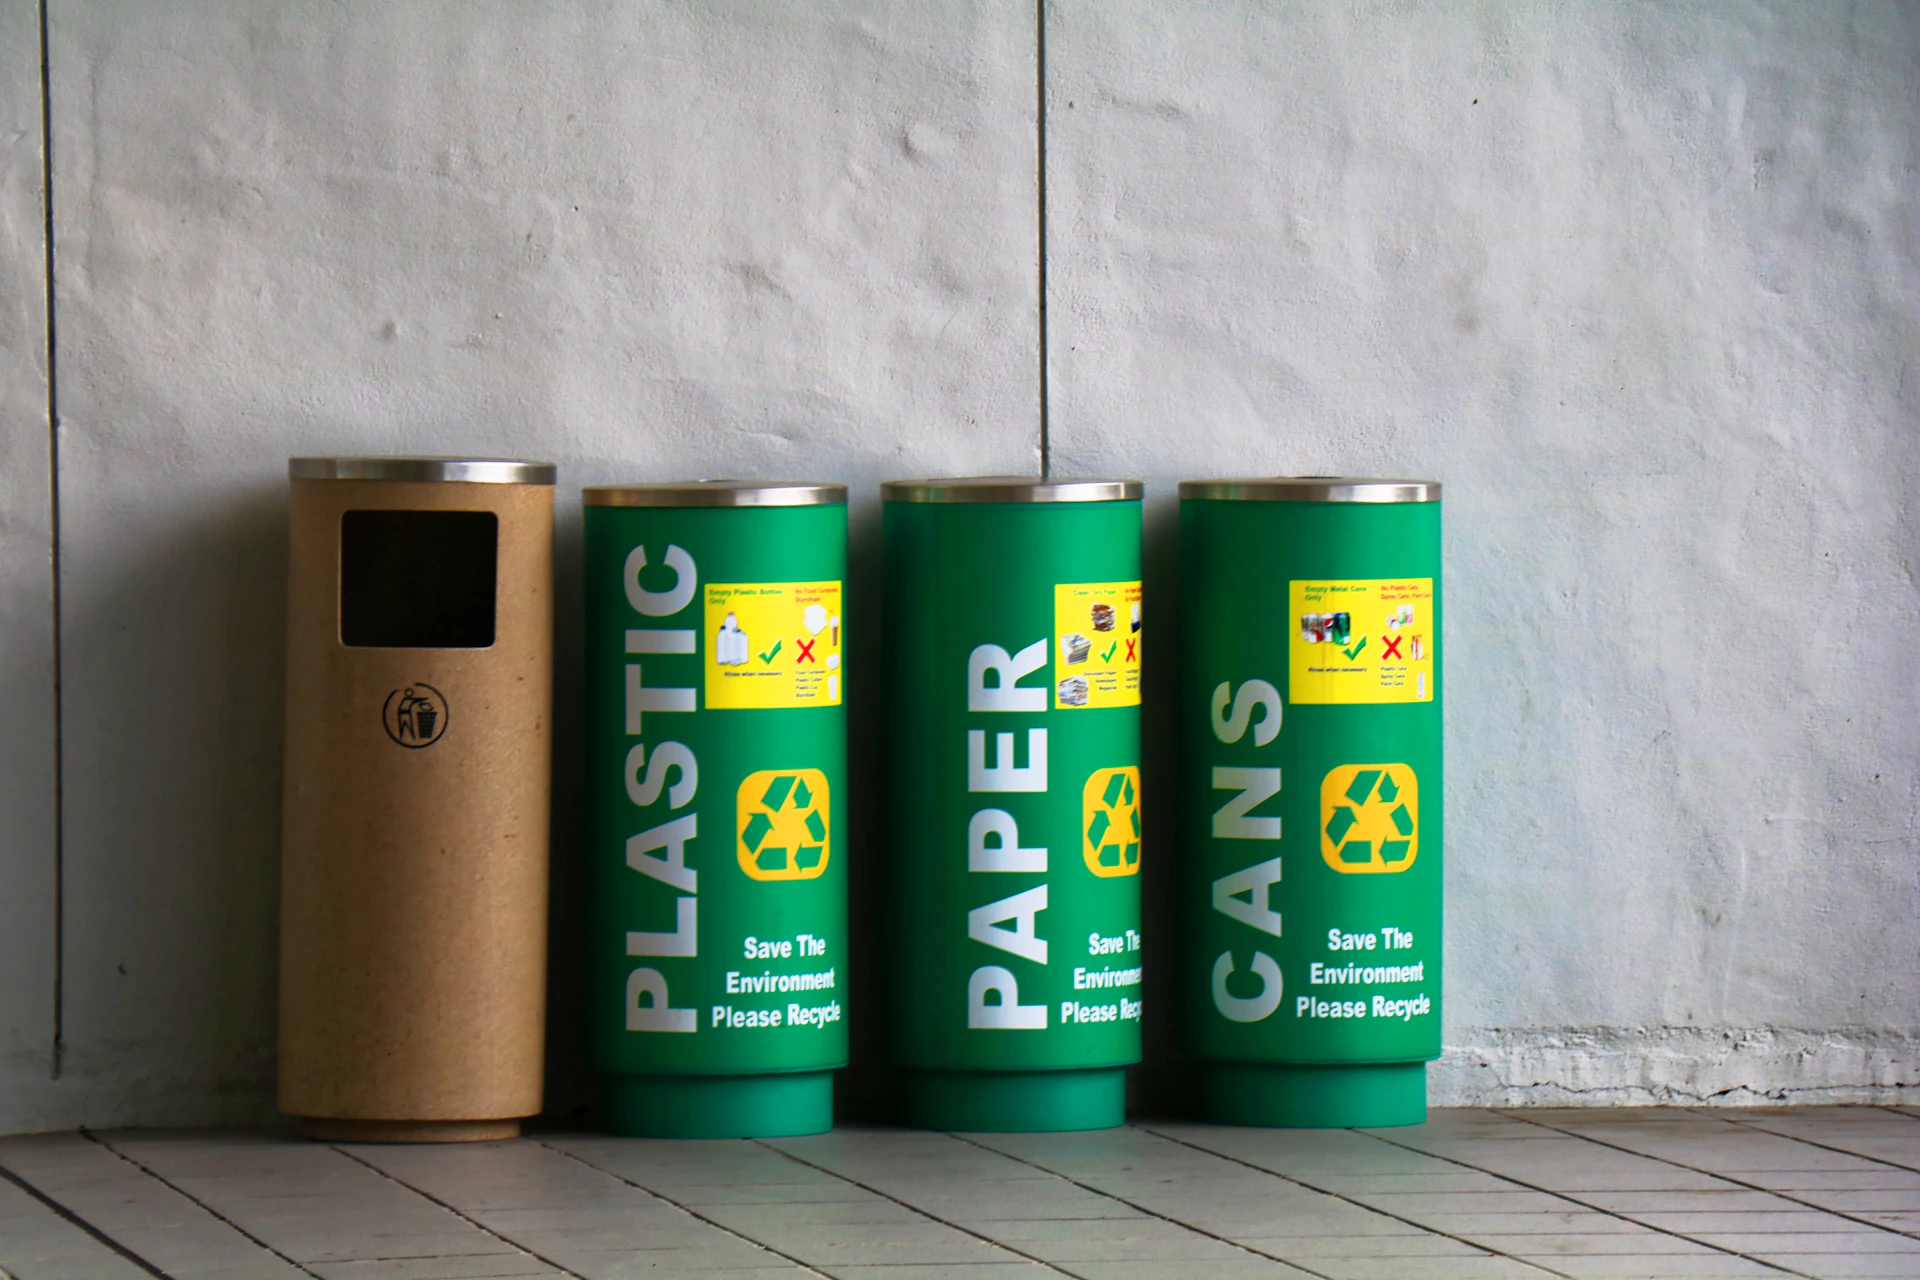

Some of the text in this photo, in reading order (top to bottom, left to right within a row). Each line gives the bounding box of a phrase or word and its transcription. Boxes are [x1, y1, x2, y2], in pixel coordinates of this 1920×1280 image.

[624, 544, 698, 1033] PLASTIC
[968, 637, 1048, 1030] PAPER
[1211, 679, 1283, 1023] CANS
[744, 934, 826, 959] Save The
[1088, 929, 1141, 955] Save The
[1328, 927, 1413, 951] Save The
[726, 967, 835, 994] Environment
[1074, 966, 1142, 990] Environme
[1310, 960, 1424, 984] Environment
[712, 1000, 840, 1029] Please Recycle
[1061, 1001, 1118, 1024] Please
[1296, 993, 1430, 1022] Please Recycle
